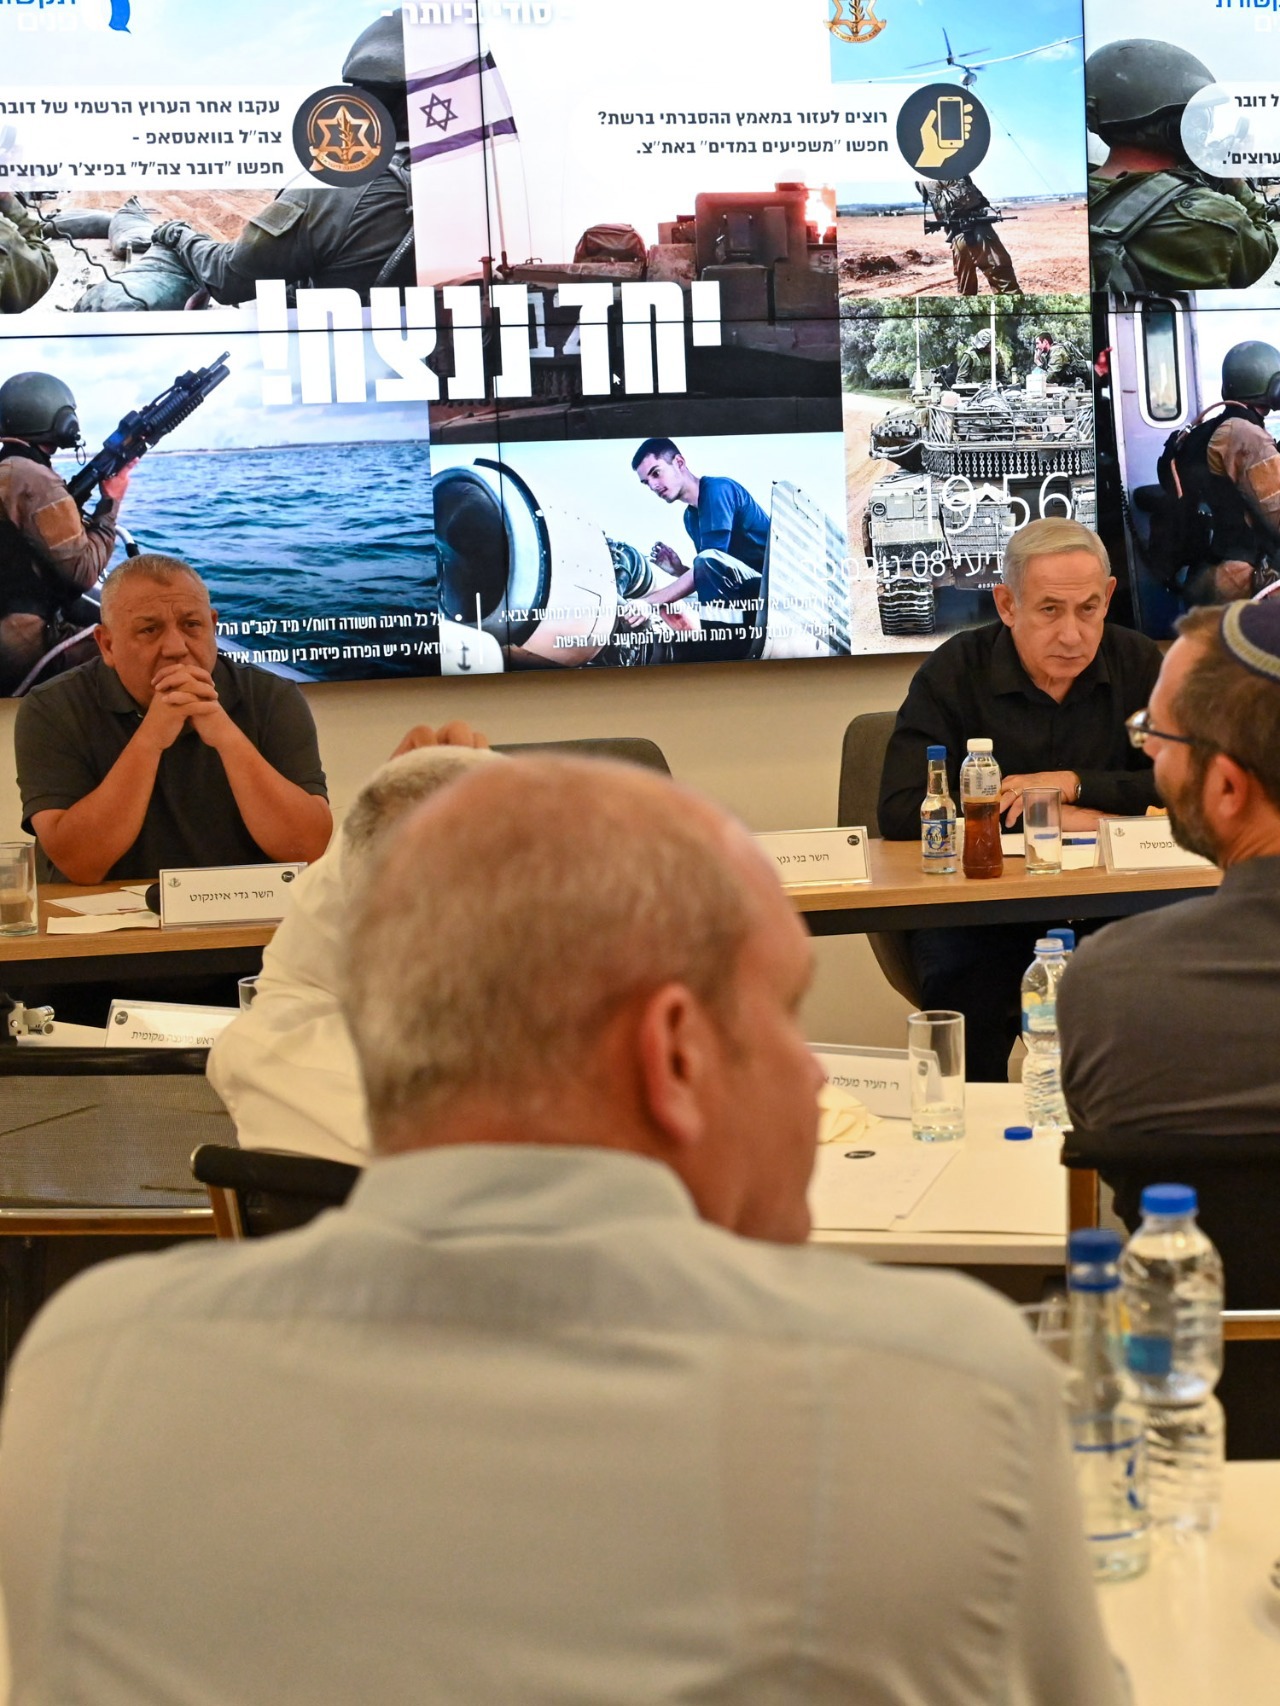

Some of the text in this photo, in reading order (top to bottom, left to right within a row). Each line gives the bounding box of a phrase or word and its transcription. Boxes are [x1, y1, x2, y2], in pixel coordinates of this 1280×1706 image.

[402, 3, 552, 24] סודי ביותר
[0, 100, 280, 116] עקבו אחר הערוץ הרשמי של דובר
[1235, 95, 1266, 107] דובר
[598, 110, 887, 126] רוצים לעזור במאמץ ההסברתי ברשת?
[146, 130, 282, 144] צה"ל בוואטסאפ
[637, 139, 888, 154] חפשו "משפיעים במדים" באת"צ.
[68, 162, 126, 176] בפיצ'ר
[131, 161, 181, 175] צה"ל"
[187, 161, 231, 175] "דובר
[237, 161, 284, 175] חפשו
[255, 279, 722, 405] יחד ננצח!
[925, 472, 1075, 534] 19:56
[912, 550, 946, 578] 08
[729, 598, 764, 611] להוציא
[280, 619, 300, 633] מיד
[339, 615, 376, 630] חשודה
[380, 614, 411, 628] חריגה
[414, 612, 428, 627] כל
[710, 628, 733, 641] רמת
[735, 628, 746, 640] פי
[749, 625, 763, 639] על
[253, 648, 289, 663] עמדות
[292, 648, 307, 664] בין
[309, 646, 340, 660] פיזית
[343, 644, 380, 659] הפרדה
[383, 643, 397, 657] יש
[400, 643, 411, 656] כי
[794, 854, 808, 863] בני
[809, 852, 830, 862] השר
[189, 889, 274, 904] השר גדי איזנקוט
[131, 1031, 165, 1044] מקומית
[196, 1036, 215, 1046] ראש
[832, 1075, 860, 1087] מעלה
[863, 1079, 887, 1089] העיר
